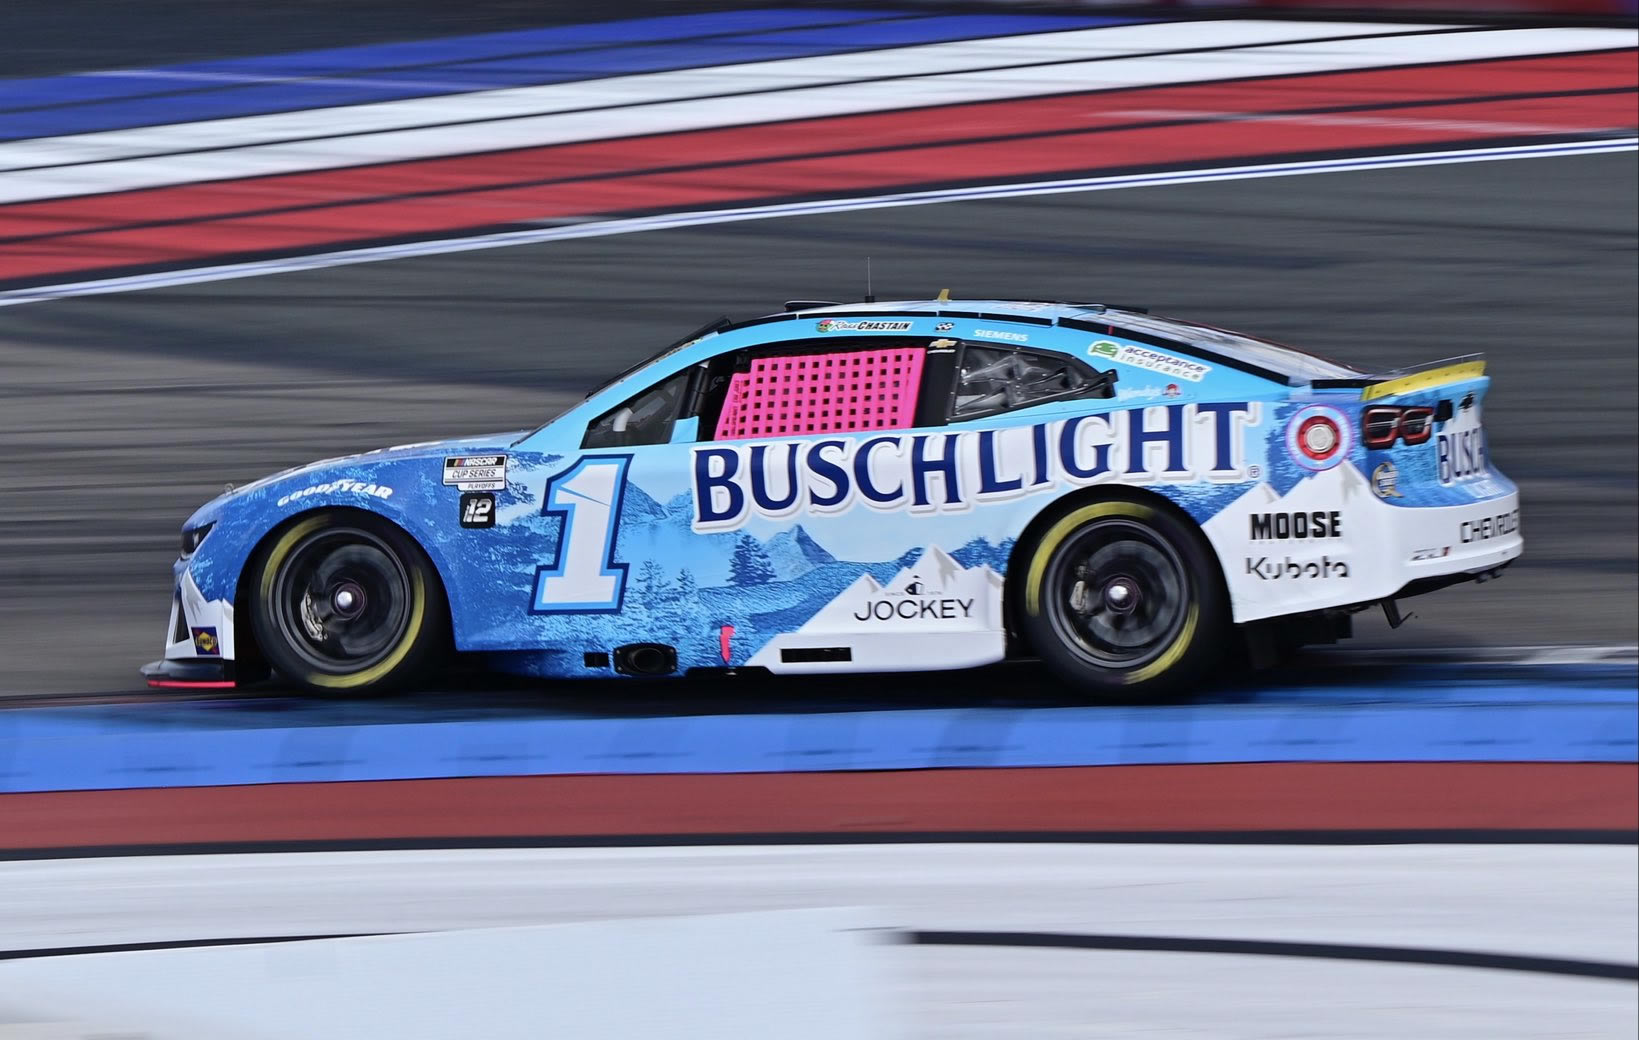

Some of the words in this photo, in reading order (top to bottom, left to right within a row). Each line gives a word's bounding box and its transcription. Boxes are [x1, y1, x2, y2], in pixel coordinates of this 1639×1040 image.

[857, 321, 910, 330] CHASTAIN
[973, 329, 1029, 342] SIEMENS
[1119, 353, 1200, 380] insurance
[1124, 346, 1207, 373] acceptance
[452, 470, 468, 479] CUP
[469, 469, 497, 478] SERIES
[464, 457, 497, 467] NASCAR
[277, 479, 393, 507] GOODYEAR
[463, 498, 493, 523] 12
[527, 453, 635, 616] 1
[1249, 510, 1343, 540] MOOSE
[1245, 555, 1350, 580] Kubota
[853, 597, 975, 622] JOCKEY
